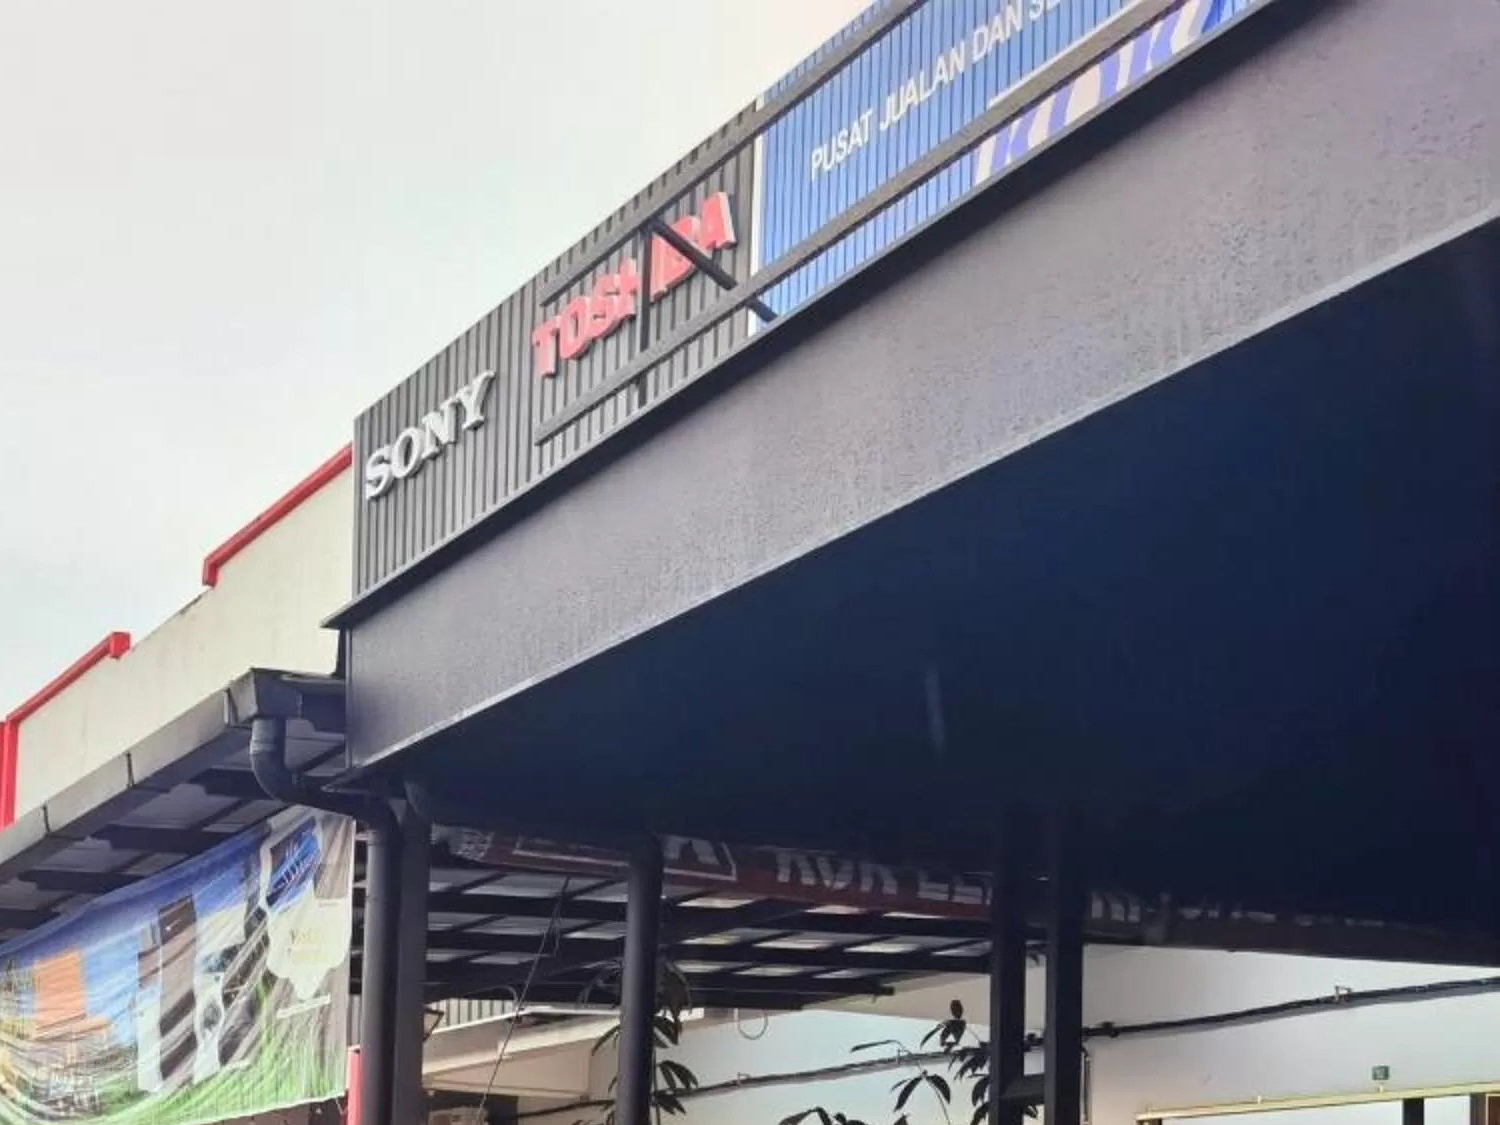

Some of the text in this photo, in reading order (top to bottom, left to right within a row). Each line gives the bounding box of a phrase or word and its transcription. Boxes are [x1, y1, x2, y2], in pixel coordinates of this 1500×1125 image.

[810, 107, 873, 182] PUSAT
[879, 40, 966, 132] JUALAN
[971, 0, 1024, 61] DAN
[531, 191, 738, 379] TOSHIBA
[364, 369, 497, 501] SONY
